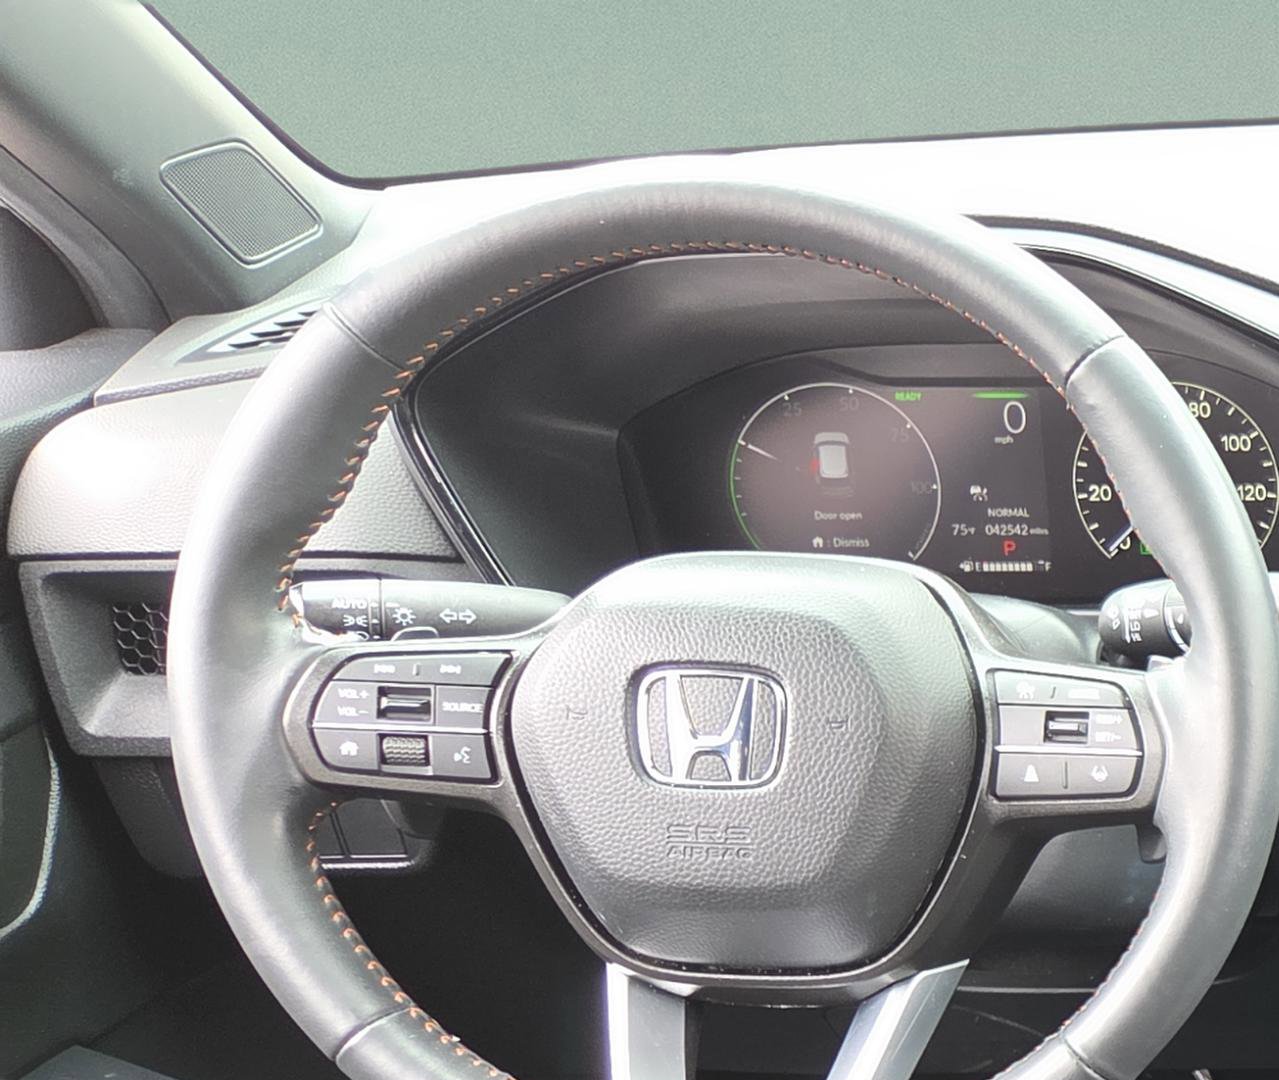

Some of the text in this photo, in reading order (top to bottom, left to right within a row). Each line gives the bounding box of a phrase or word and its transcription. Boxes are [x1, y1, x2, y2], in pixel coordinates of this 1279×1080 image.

[895, 392, 922, 401] READY
[1002, 400, 1026, 434] 0
[1220, 434, 1251, 452] 100
[1088, 485, 1112, 501] 20
[1235, 484, 1267, 501] 120
[814, 510, 863, 522] Door open
[987, 507, 1030, 518] NORMAL
[985, 523, 1028, 537] 042542
[832, 537, 871, 549] Dismiss
[1003, 540, 1016, 557] P
